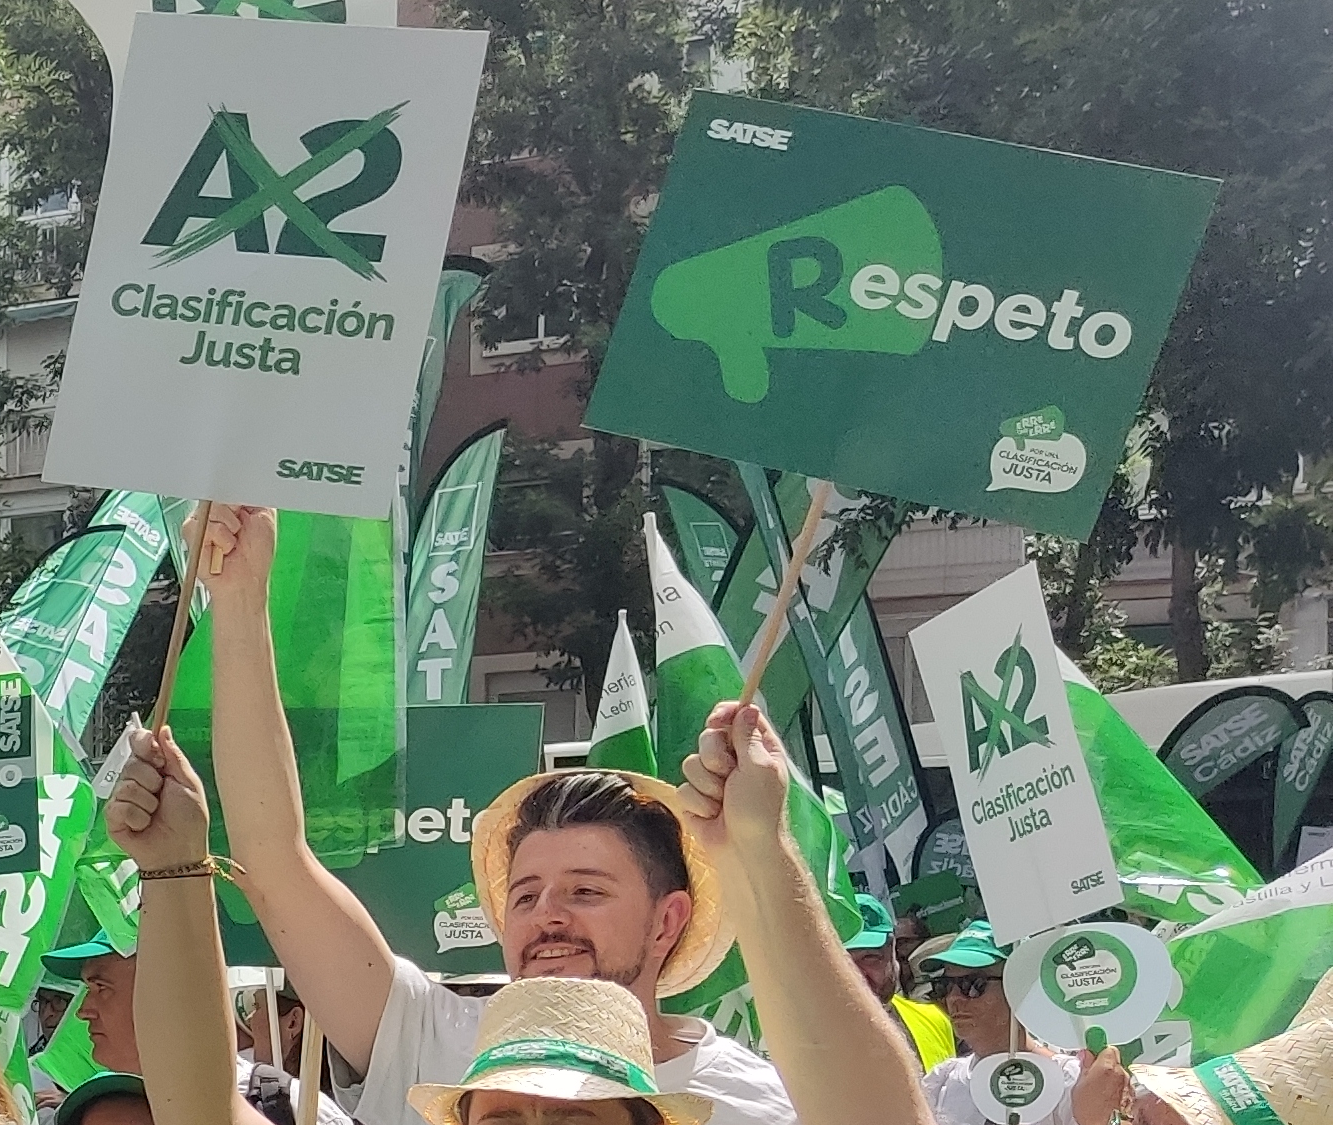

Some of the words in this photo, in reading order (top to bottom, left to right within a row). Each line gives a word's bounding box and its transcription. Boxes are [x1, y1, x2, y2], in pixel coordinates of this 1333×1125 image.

[708, 118, 793, 151] SATSE
[140, 112, 402, 262] A2
[110, 282, 395, 340] Clasificación
[766, 235, 1132, 359] Respeto
[179, 331, 301, 375] Justa
[275, 458, 365, 485] SATSE
[999, 450, 1078, 474] CLASIFICACIÓN
[1003, 463, 1052, 484] JUSTA
[0, 678, 22, 752] SATSE
[960, 646, 1050, 774] A2
[1180, 702, 1268, 766] SATSE
[1194, 724, 1281, 783] Cádiz
[972, 764, 1075, 825] Clasificación
[1008, 807, 1052, 842] Justa
[1071, 871, 1106, 894] SATSE
[445, 929, 483, 939] JUSTA
[1068, 976, 1105, 988] JUSTA
